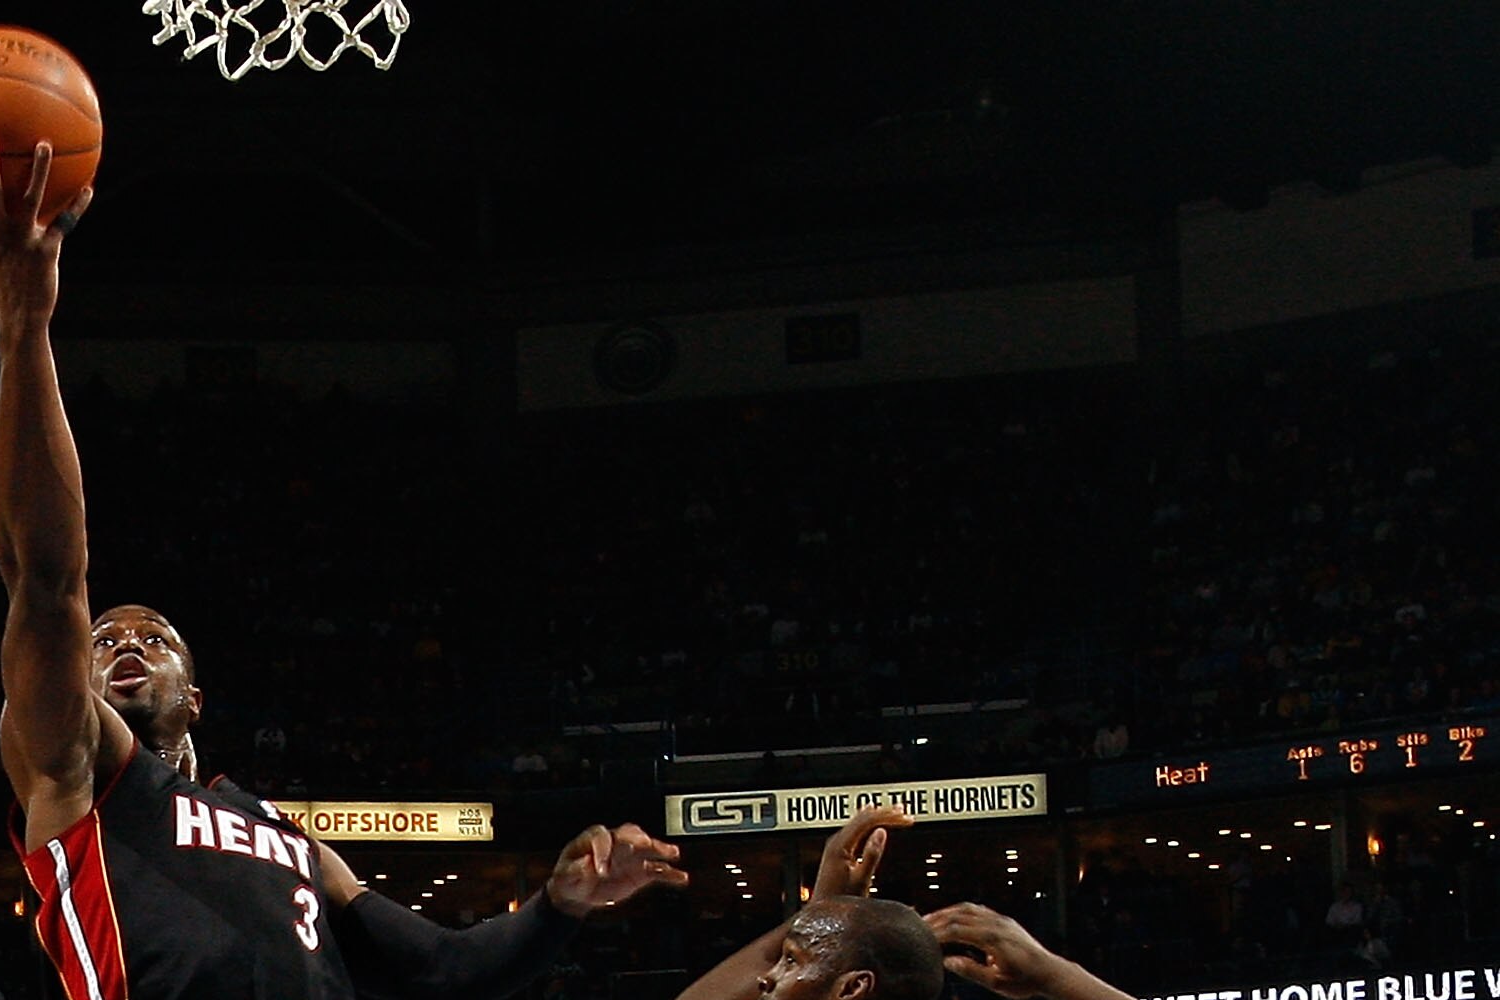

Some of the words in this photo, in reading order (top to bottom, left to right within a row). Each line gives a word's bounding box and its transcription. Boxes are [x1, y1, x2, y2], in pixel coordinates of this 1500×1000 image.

[1155, 761, 1209, 788] Heat
[1297, 760, 1308, 780] 1
[1350, 753, 1364, 774] 6
[1404, 747, 1417, 768] 1
[1458, 740, 1474, 762] 2
[314, 811, 439, 833] OFFSHORE
[689, 796, 771, 828] CST
[787, 794, 850, 822] HOME
[888, 790, 927, 816] THE
[933, 783, 1036, 814] HORNETS
[174, 794, 312, 880] HEAT
[291, 886, 320, 952] 3
